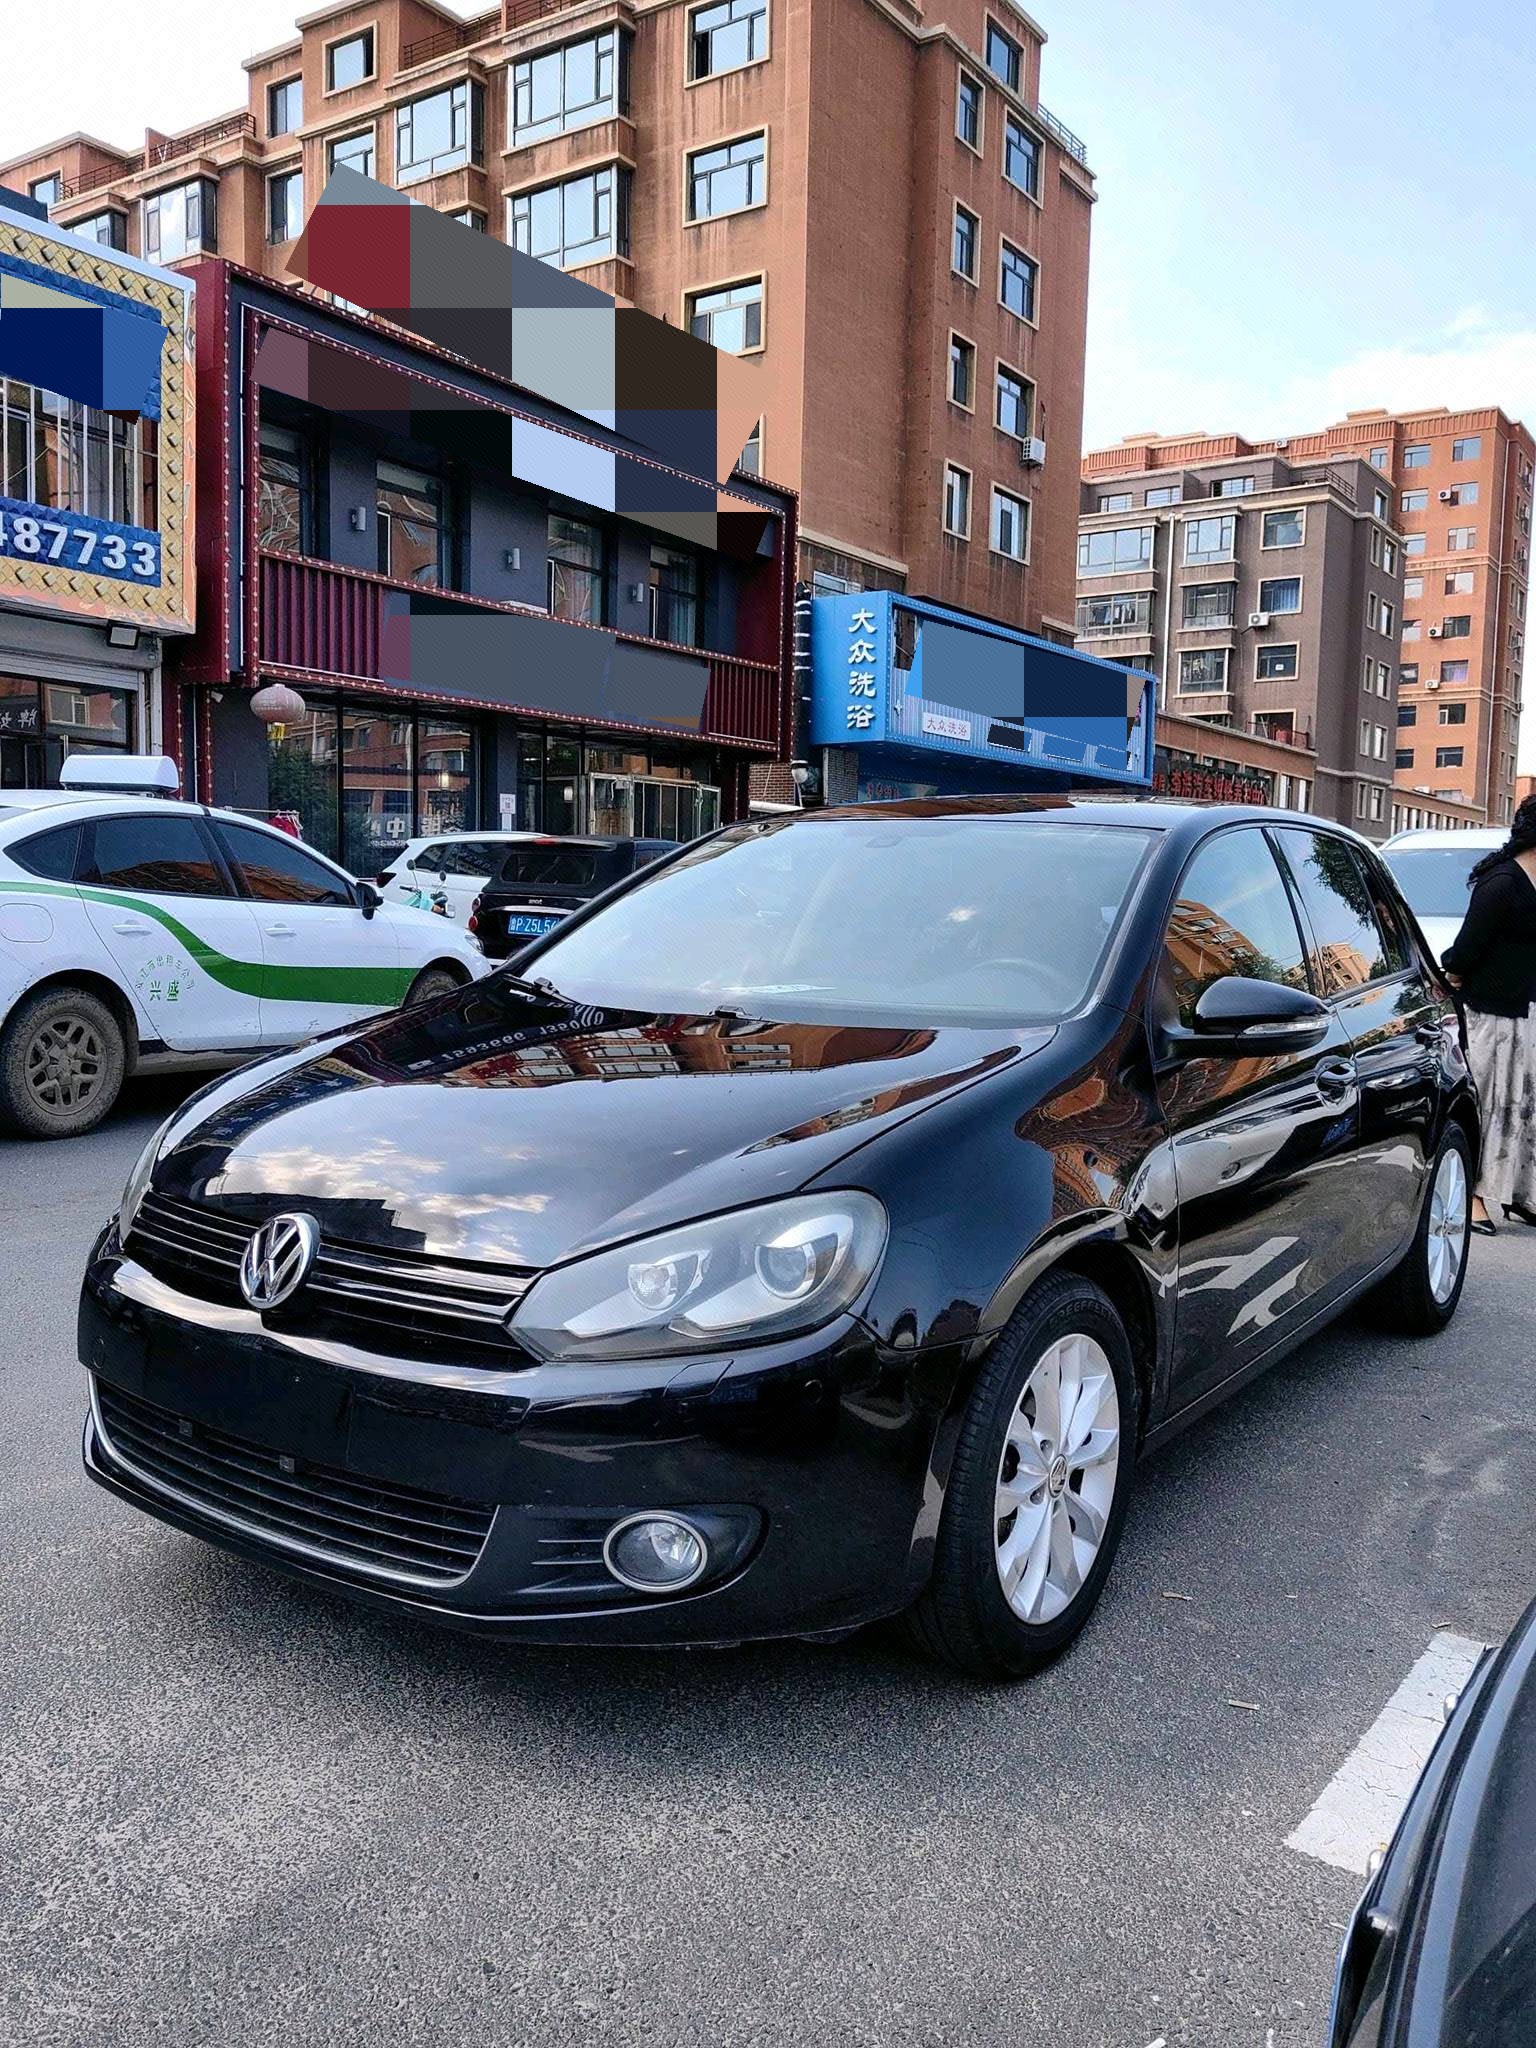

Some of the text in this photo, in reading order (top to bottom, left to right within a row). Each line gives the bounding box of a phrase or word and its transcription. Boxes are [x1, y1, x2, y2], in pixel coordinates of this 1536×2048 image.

[847, 608, 877, 729] 大众洗浴
[149, 980, 180, 1001] 兴盛
